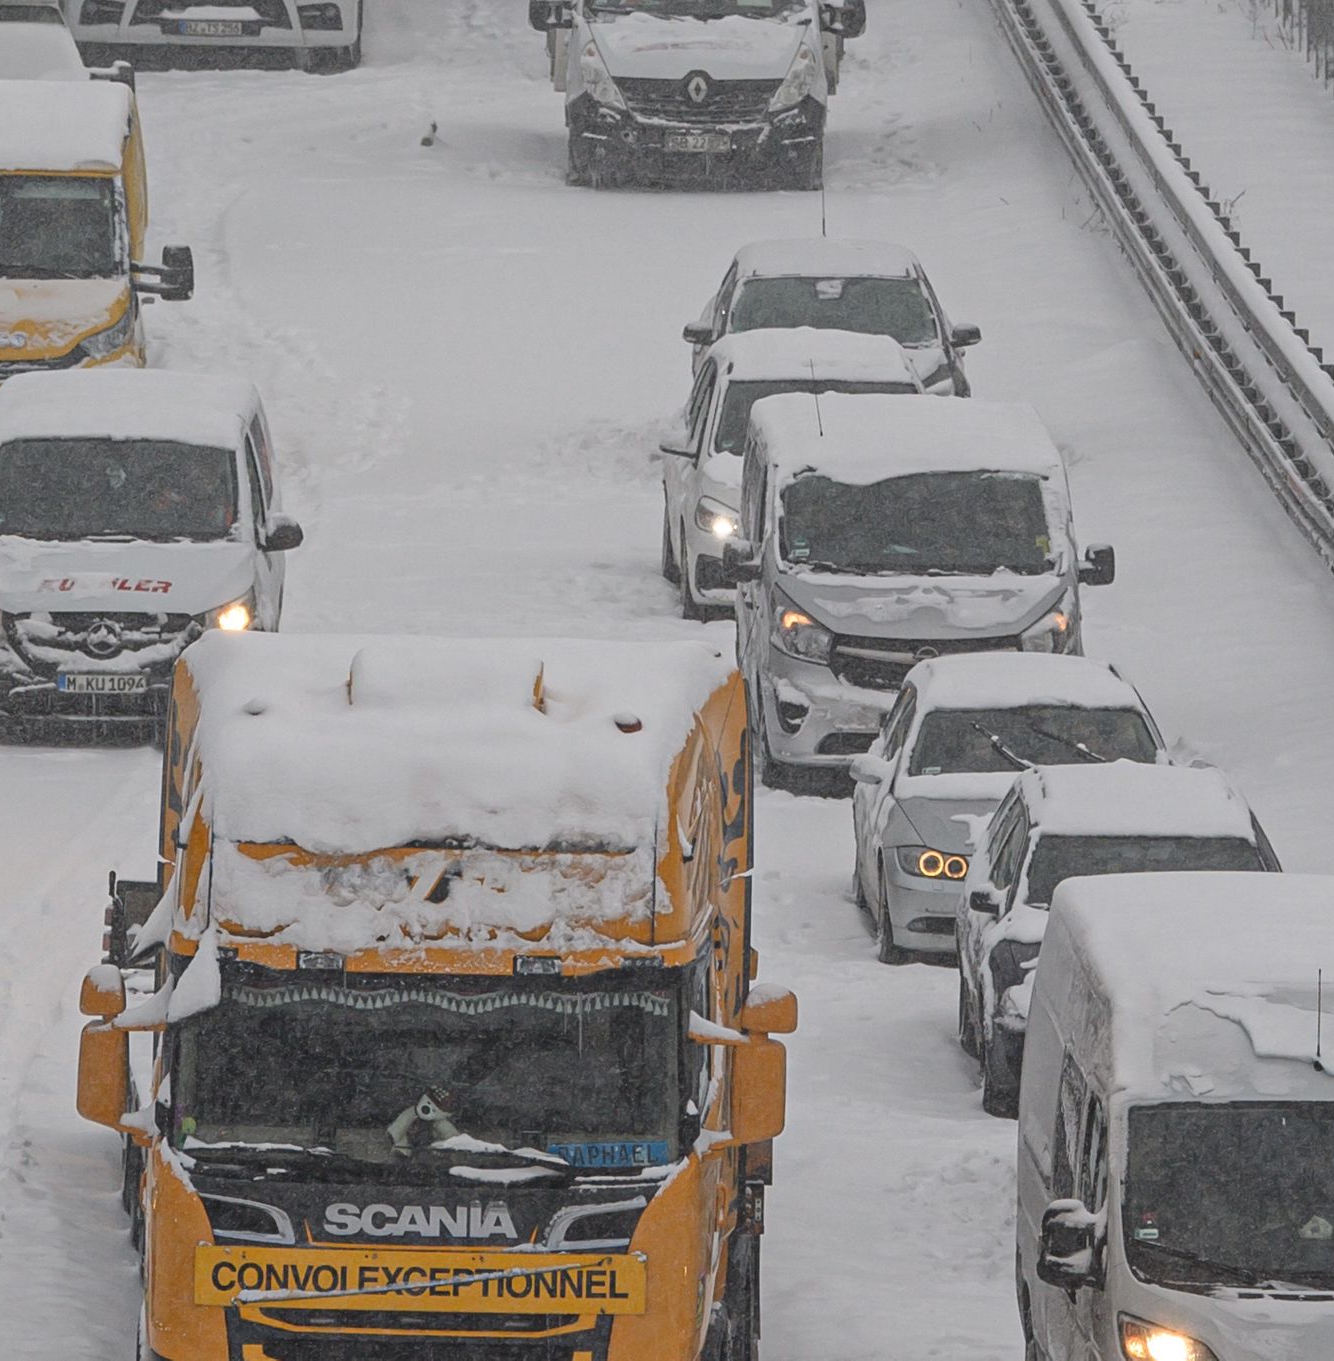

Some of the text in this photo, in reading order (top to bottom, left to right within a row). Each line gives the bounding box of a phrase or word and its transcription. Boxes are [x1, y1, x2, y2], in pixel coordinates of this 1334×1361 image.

[323, 1201, 518, 1238] SCANIA
[212, 1260, 629, 1299] CONVOI EXCEPTIONNEL
